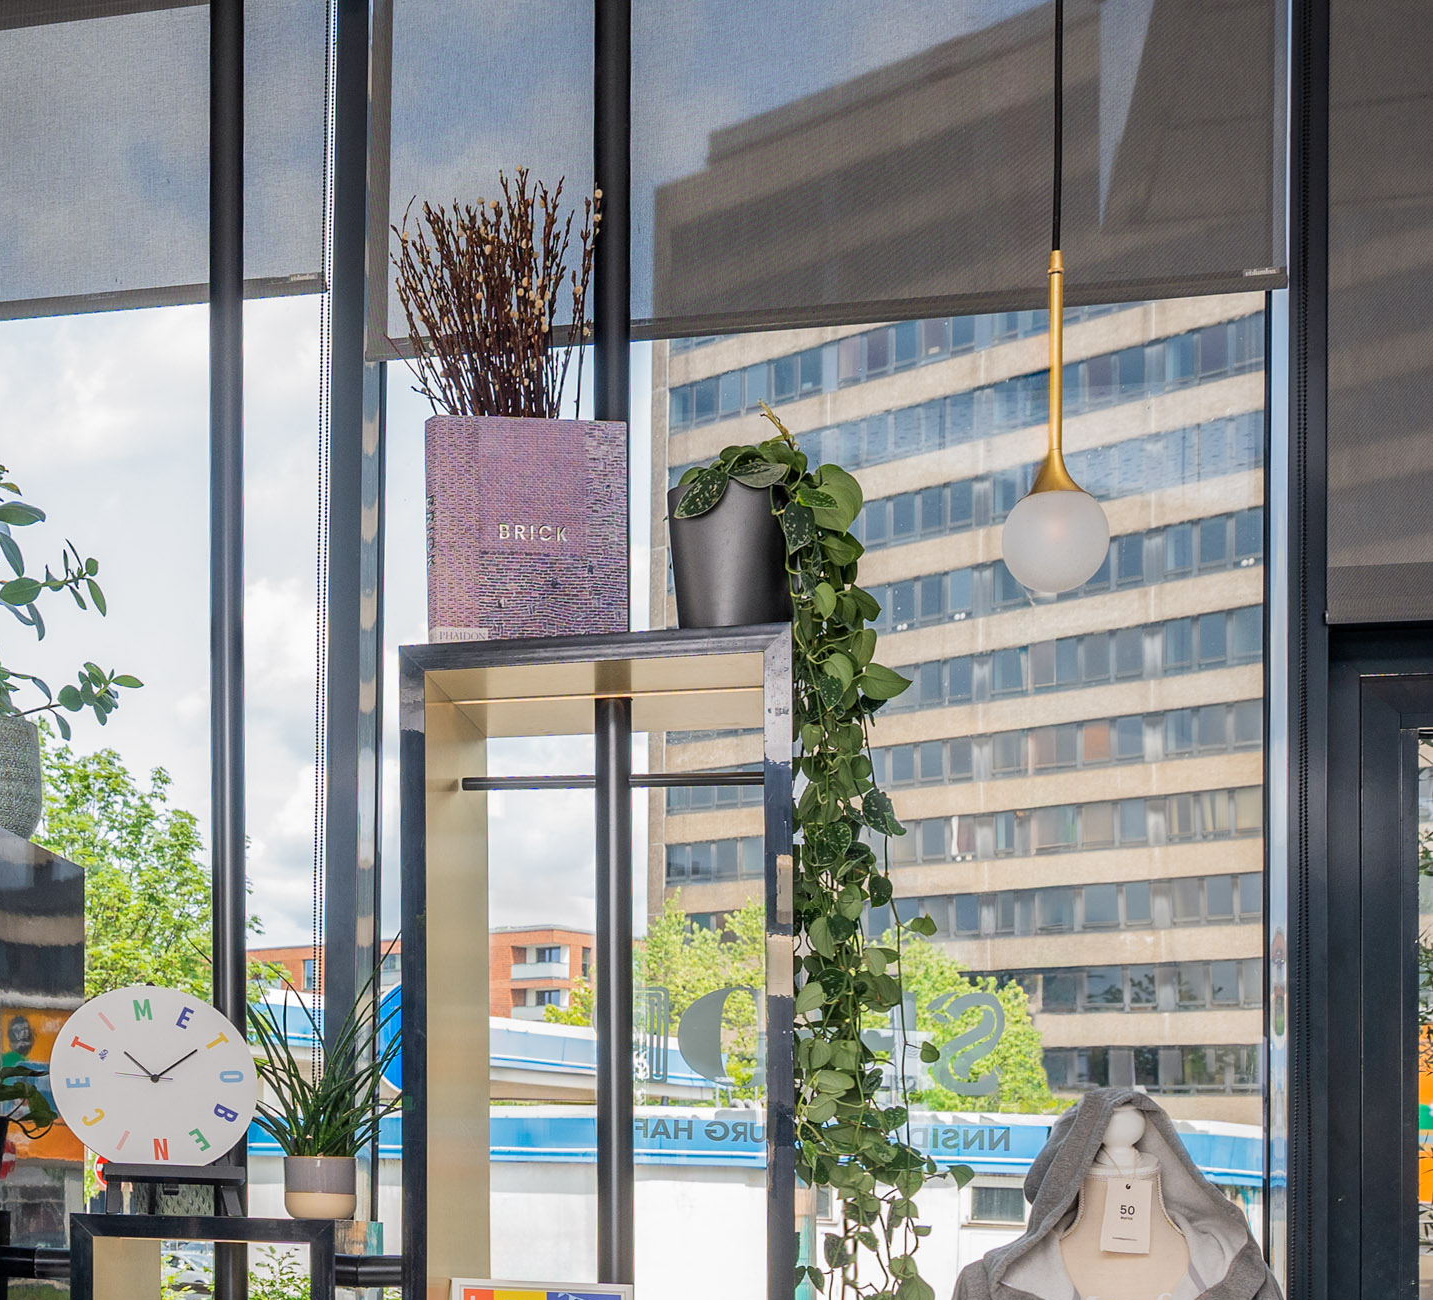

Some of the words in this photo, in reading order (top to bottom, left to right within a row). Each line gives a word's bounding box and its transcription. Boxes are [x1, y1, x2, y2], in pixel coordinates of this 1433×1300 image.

[499, 522, 568, 542] BRICK
[439, 631, 486, 641] PHAIDON
[1119, 1204, 1136, 1217] 50
